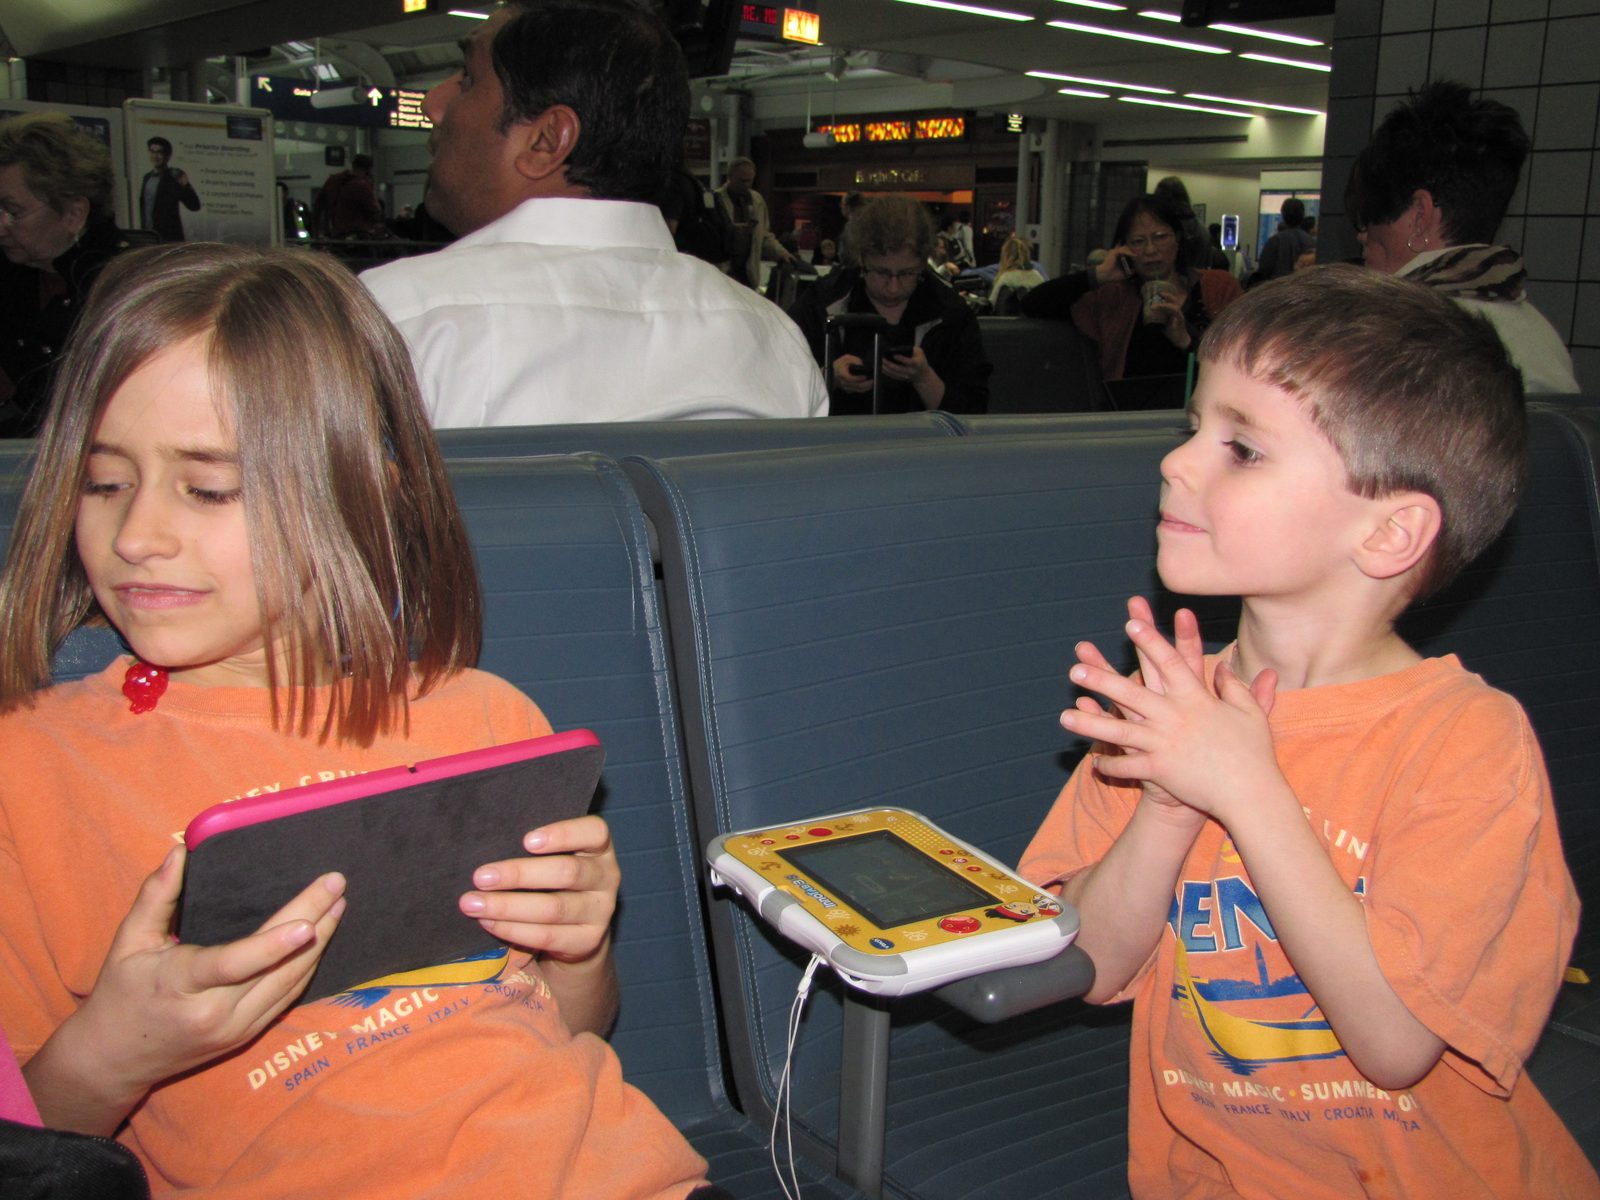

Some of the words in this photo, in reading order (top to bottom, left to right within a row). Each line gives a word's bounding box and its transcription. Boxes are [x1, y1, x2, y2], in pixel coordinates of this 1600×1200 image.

[786, 10, 818, 39] EXIT
[351, 988, 440, 1034] MAGIC
[285, 1056, 331, 1092] SPAIN
[346, 1023, 412, 1055] FRANCE
[1222, 1081, 1286, 1102] MAGIC
[1223, 1103, 1272, 1115] FRANCE
